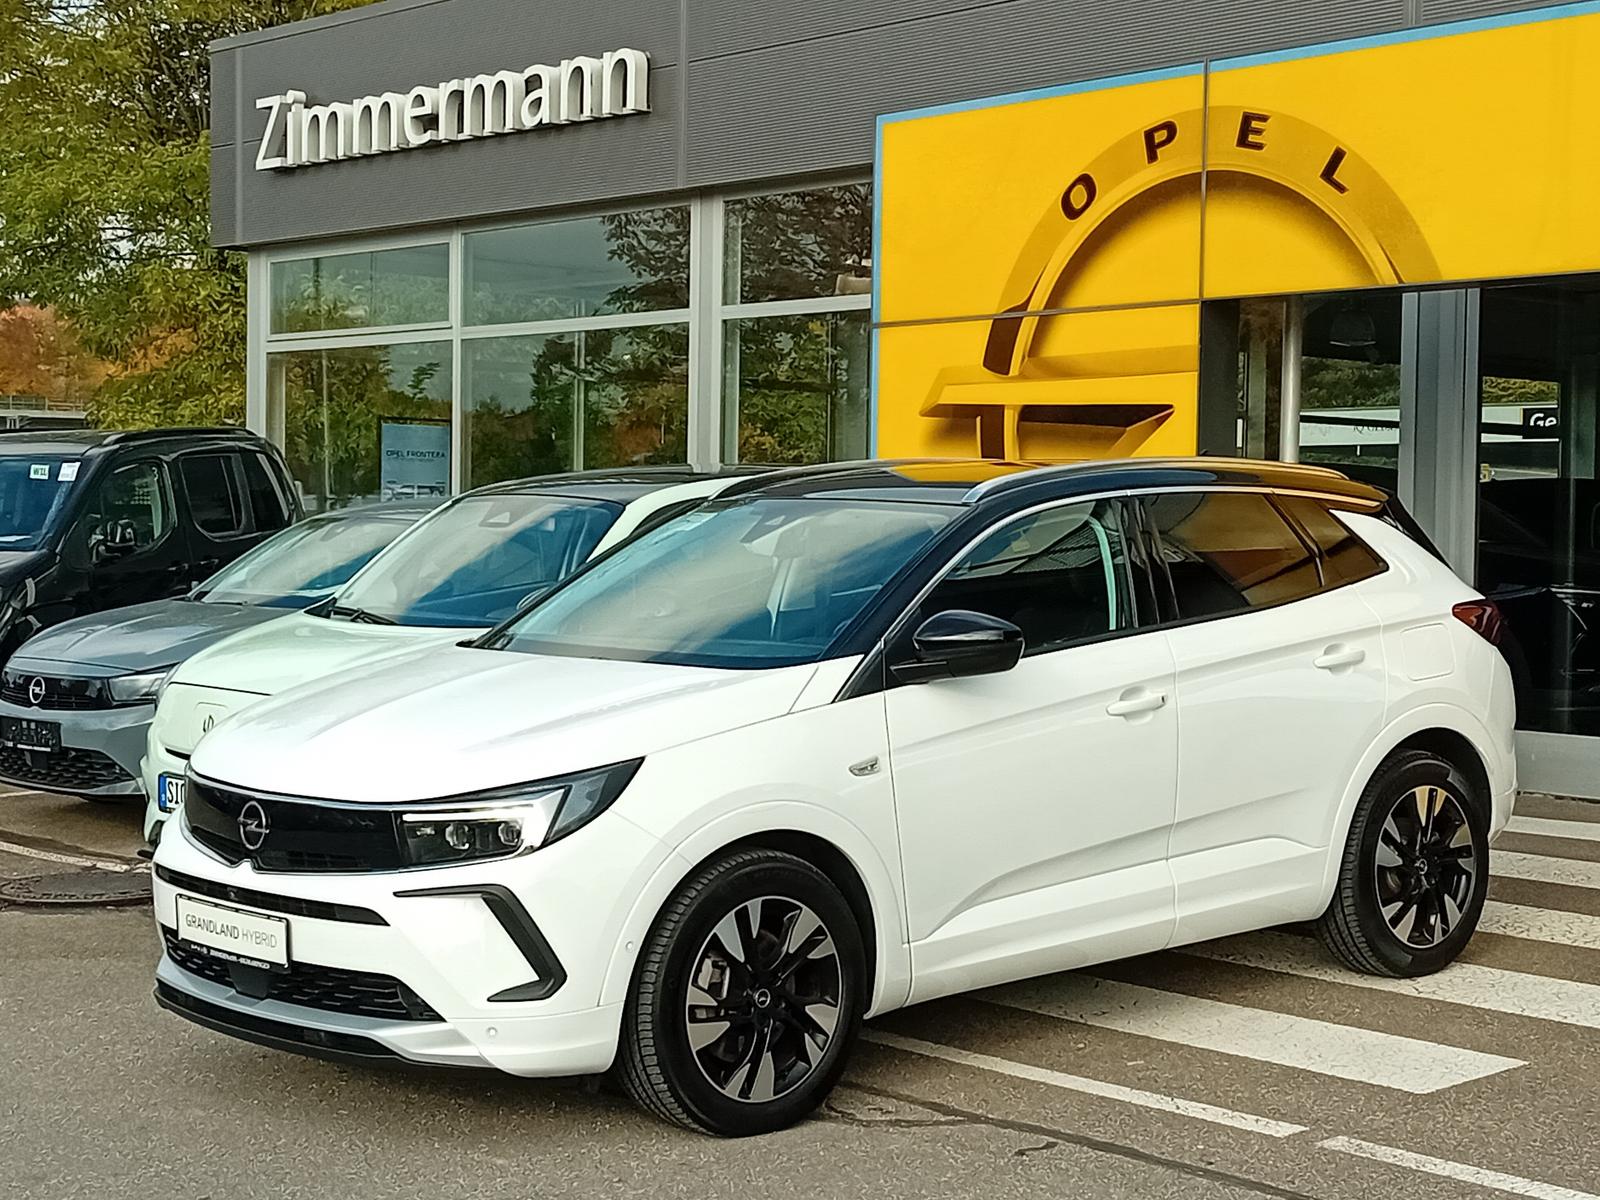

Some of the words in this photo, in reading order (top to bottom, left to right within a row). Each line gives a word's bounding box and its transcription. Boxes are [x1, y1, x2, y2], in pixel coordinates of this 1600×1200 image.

[255, 48, 652, 171] Zimmermann
[1060, 111, 1350, 220] OPEL
[185, 913, 240, 940] GRANDLAND
[241, 928, 278, 949] HYBRID
